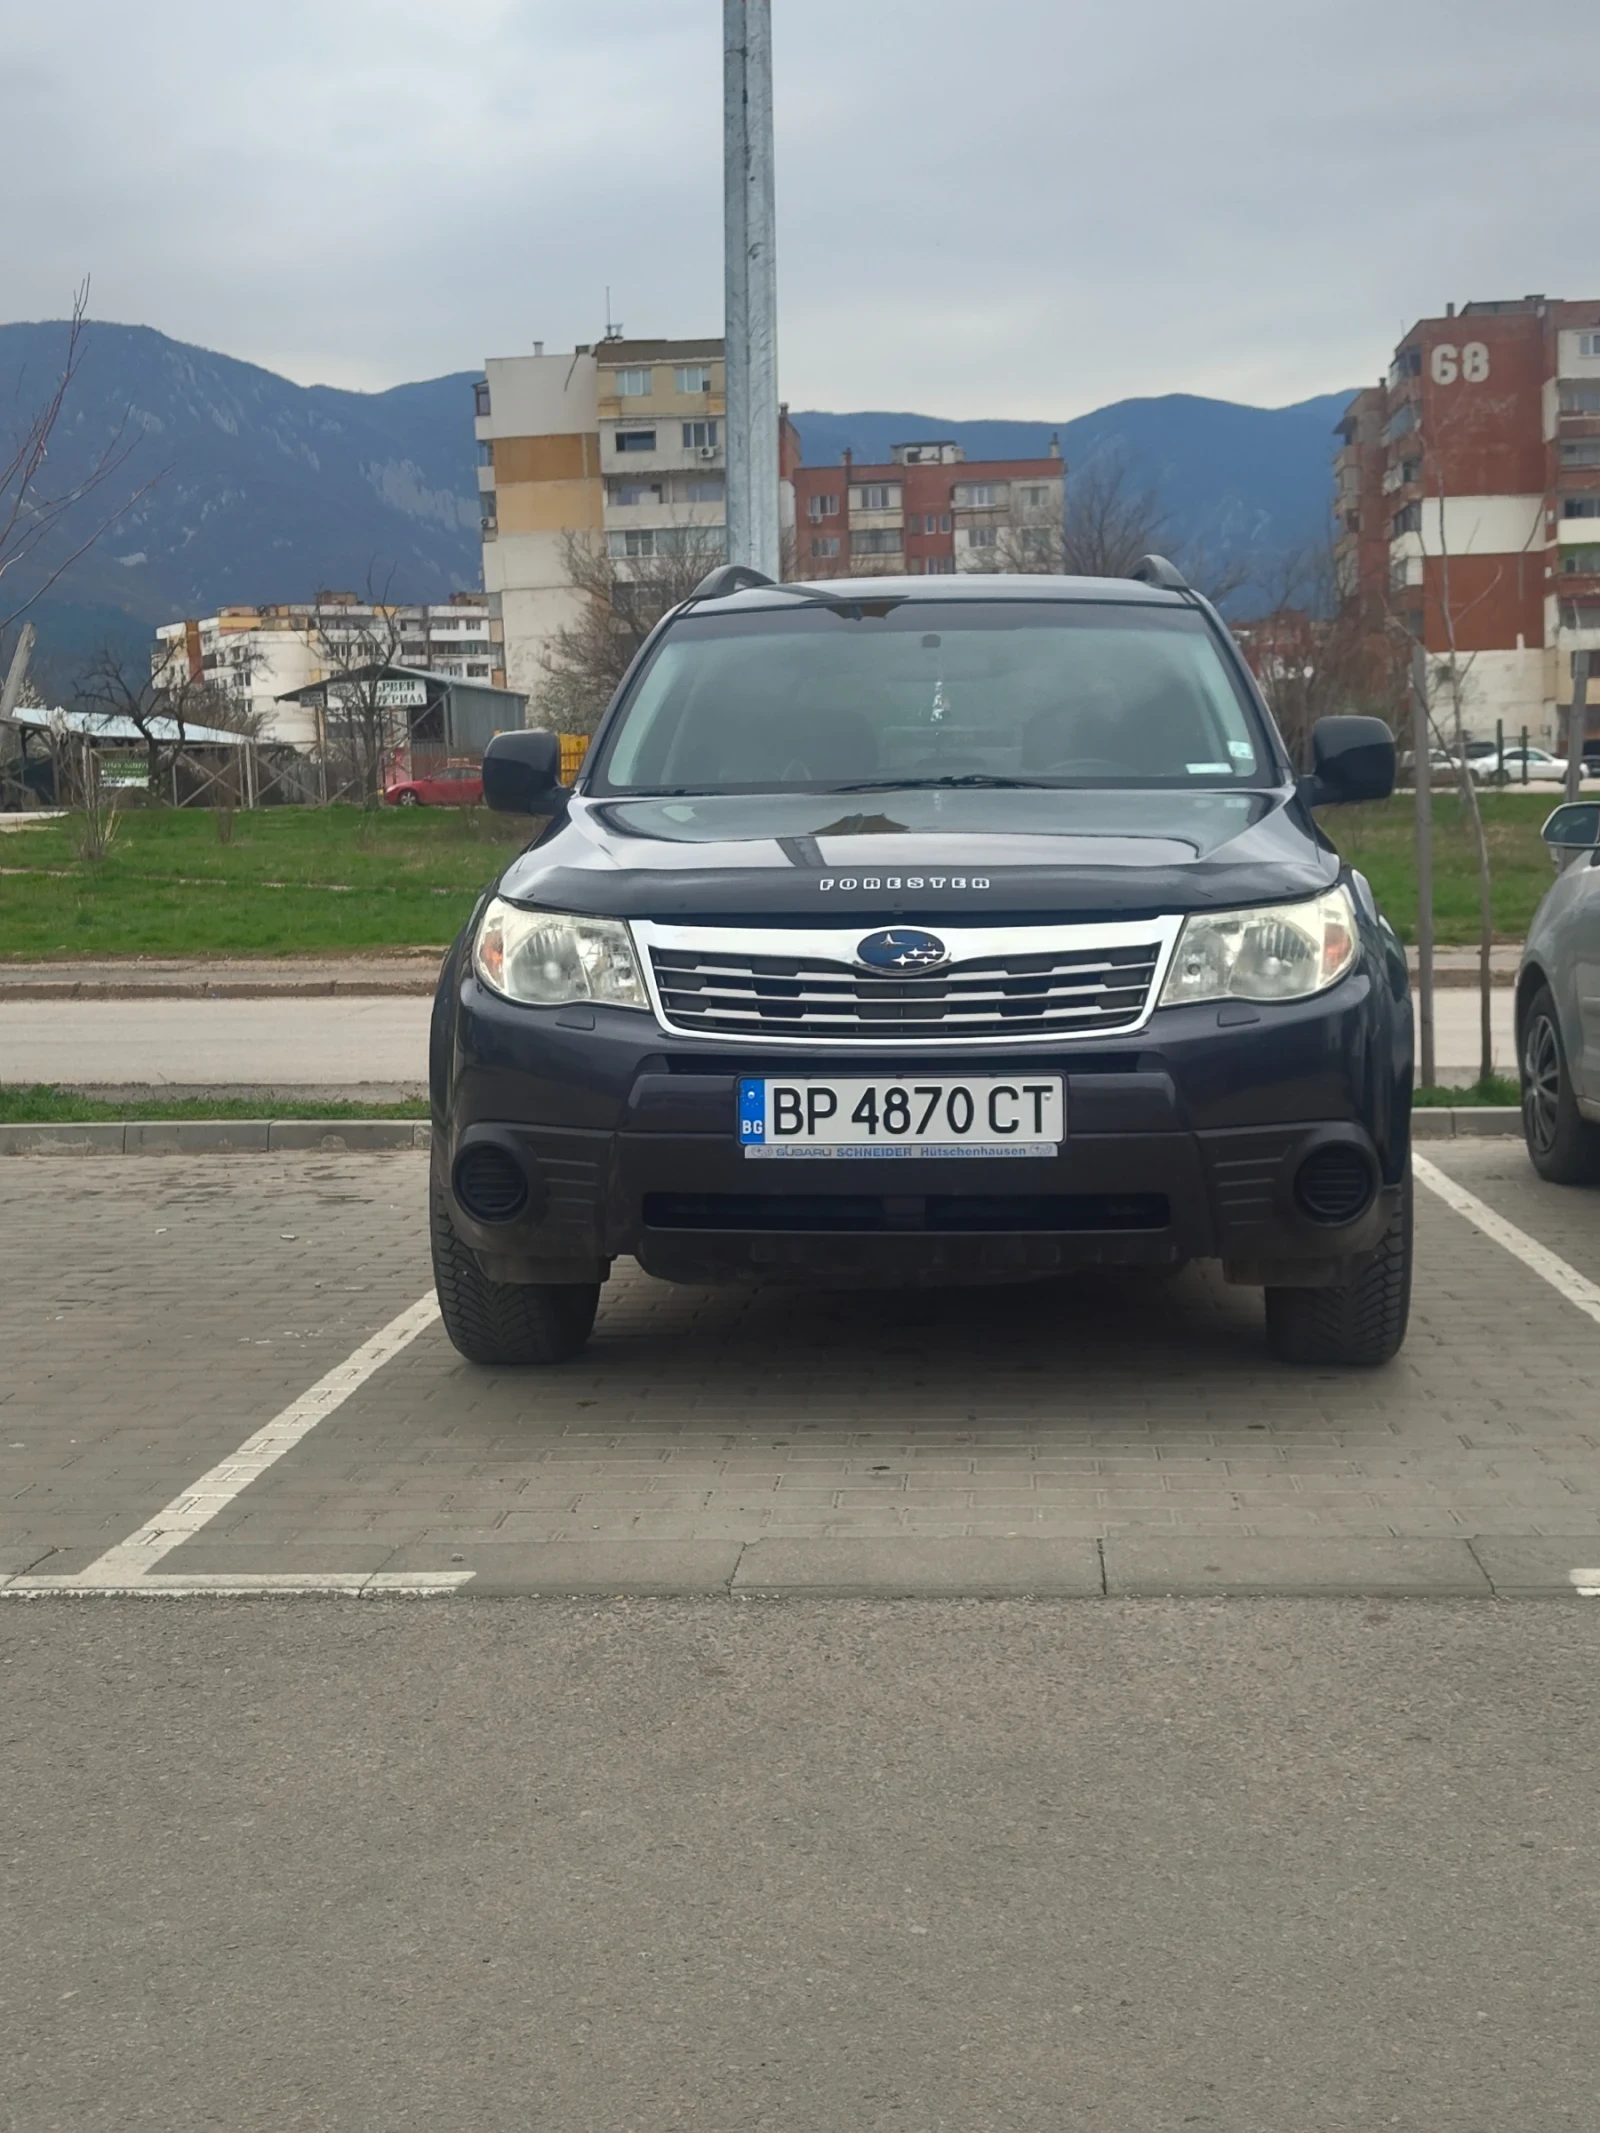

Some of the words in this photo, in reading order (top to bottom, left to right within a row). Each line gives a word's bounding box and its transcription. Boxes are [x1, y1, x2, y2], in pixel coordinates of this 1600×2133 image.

[1431, 342, 1489, 385] 68
[367, 681, 416, 692] РВЕН
[819, 877, 990, 891] FORESTER
[773, 1086, 838, 1135] BP
[851, 1086, 975, 1135] 4870
[987, 1085, 1054, 1134] CT
[742, 1119, 763, 1134] BG
[776, 1147, 832, 1157] SUBARU
[836, 1147, 912, 1157] SCHNEIDER
[920, 1146, 1026, 1157] Hütschenhausen
